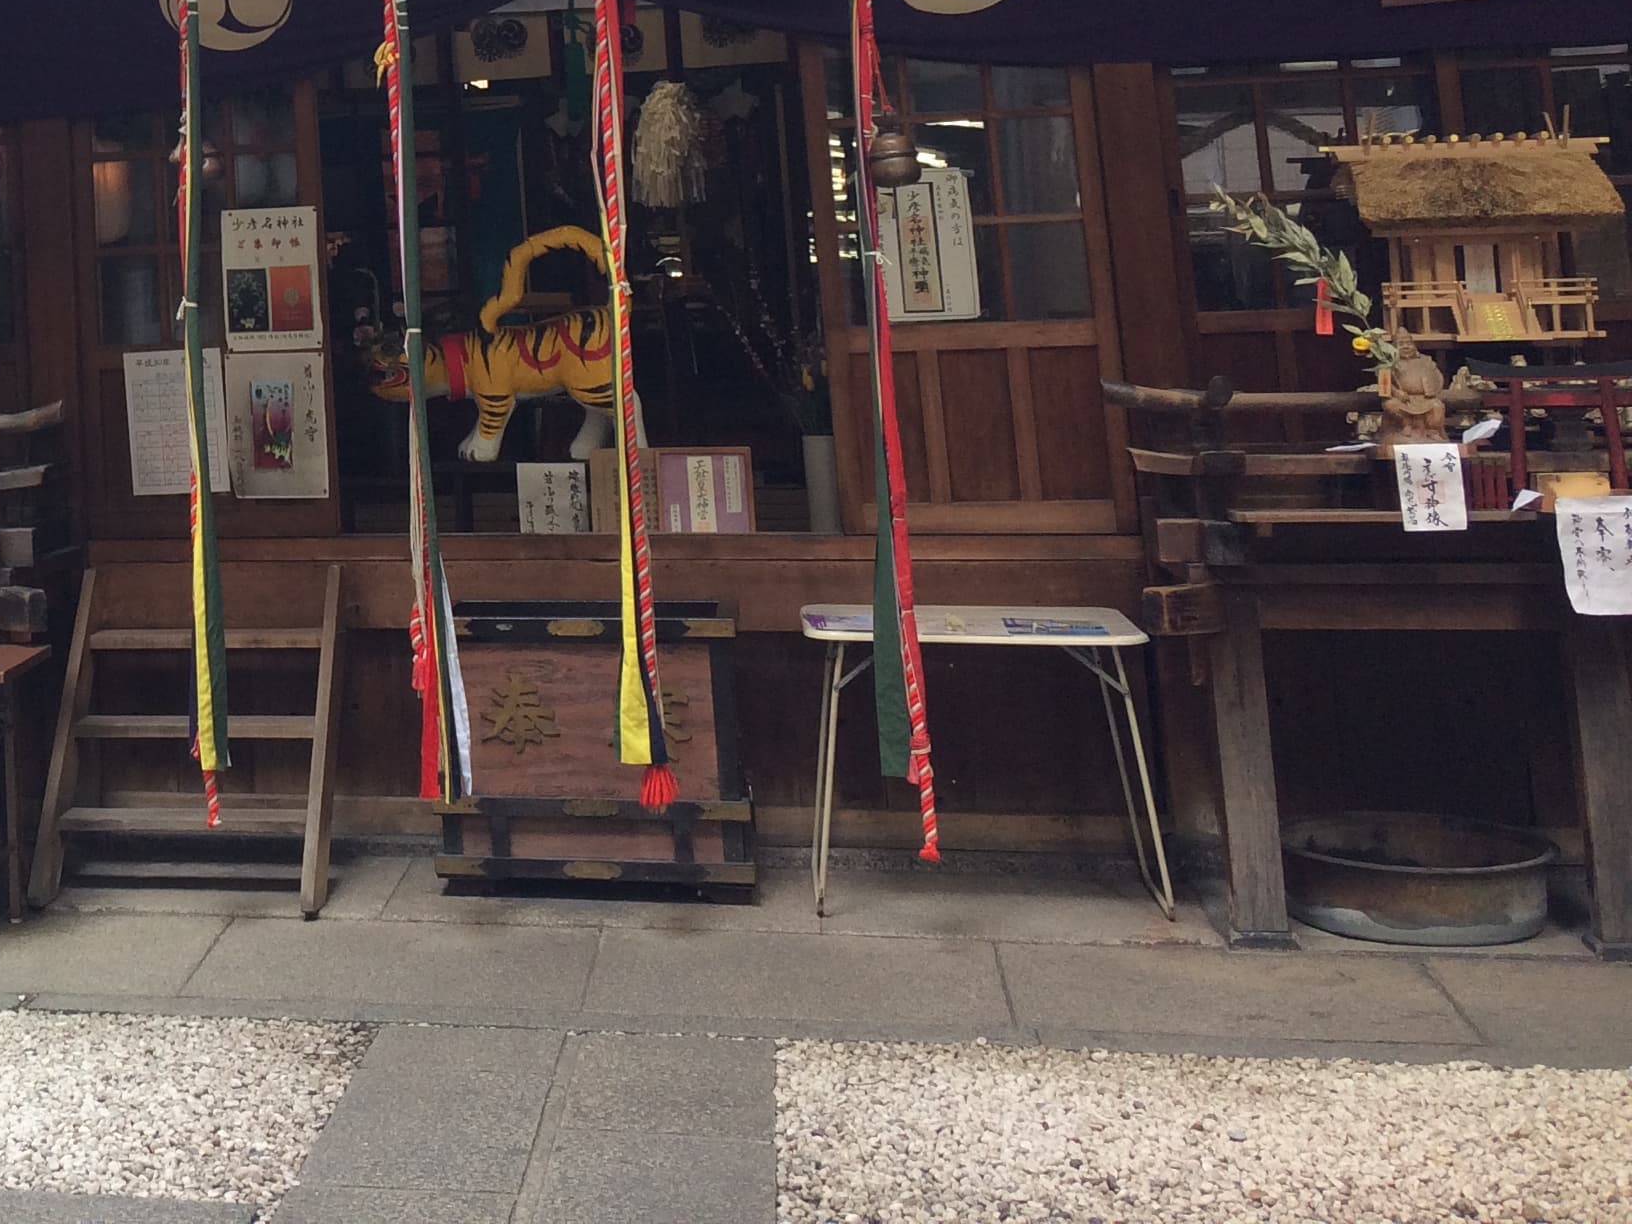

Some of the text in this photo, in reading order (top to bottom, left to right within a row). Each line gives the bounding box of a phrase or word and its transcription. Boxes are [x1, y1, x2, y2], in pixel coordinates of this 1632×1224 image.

[232, 216, 305, 231] 少彦名神社
[237, 237, 300, 251] ご朱印帳
